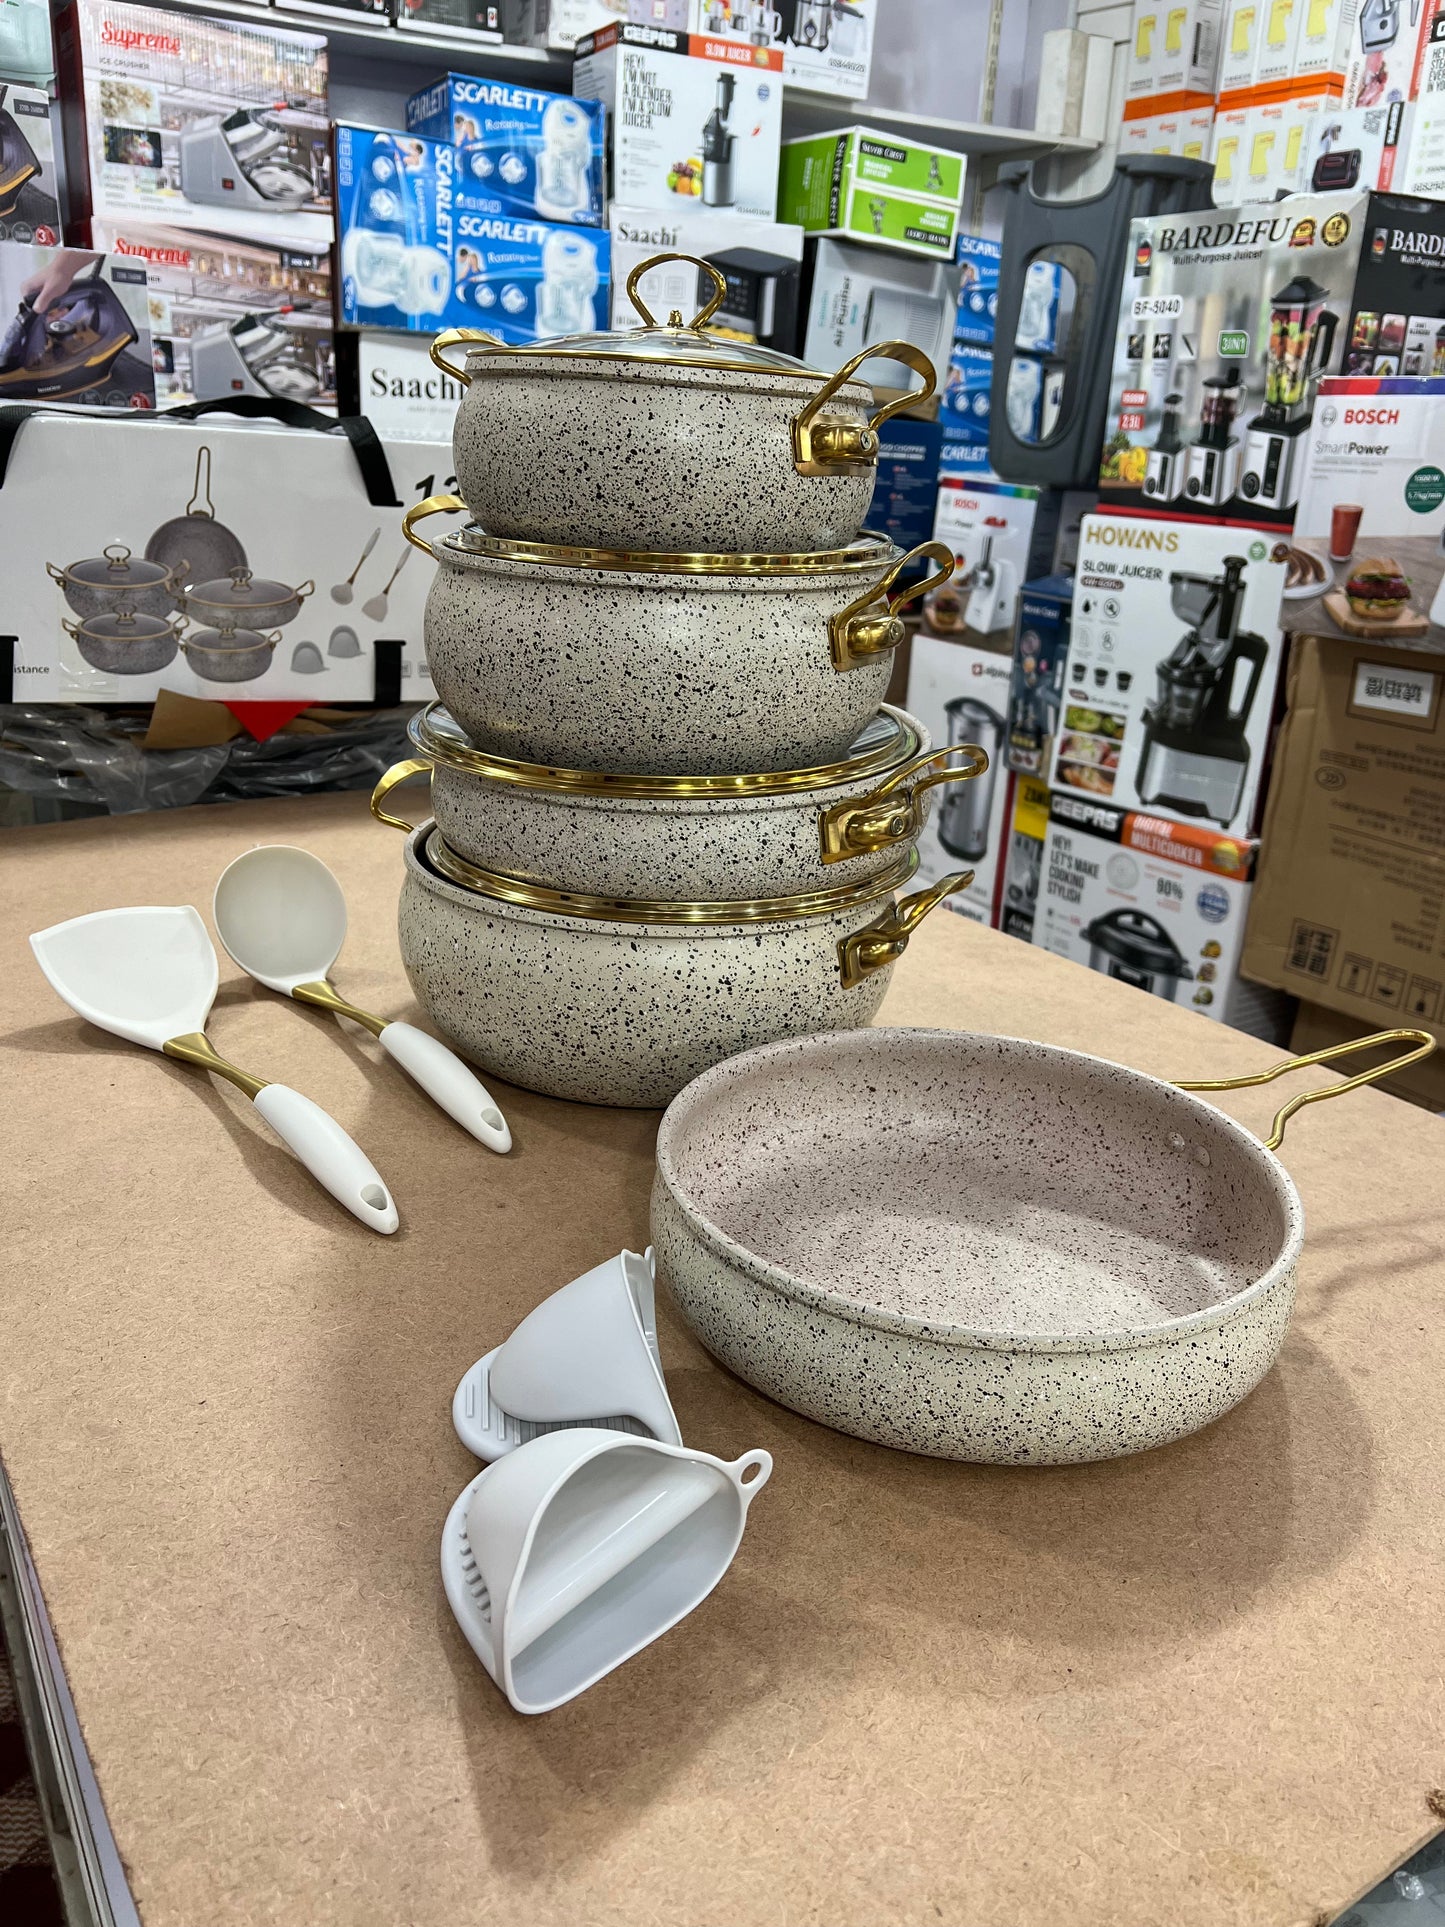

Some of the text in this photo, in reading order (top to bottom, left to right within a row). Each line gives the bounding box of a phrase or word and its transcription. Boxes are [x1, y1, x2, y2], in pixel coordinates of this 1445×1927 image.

[101, 20, 181, 54] Supreme
[705, 43, 752, 62] SLOW JUICER
[453, 81, 548, 113] SCARLETT
[434, 145, 453, 256] SCARLETT
[457, 215, 550, 246] SCARLETT
[617, 222, 677, 247] Saachi
[1159, 217, 1293, 252] BARDEFU
[115, 238, 191, 266] Supreme
[833, 328, 844, 347] Air
[1344, 409, 1400, 425] BOSCH
[1315, 441, 1390, 455] SmartPower
[1086, 524, 1180, 553] HOWANS
[1083, 560, 1163, 580] SLOW JUICER
[1052, 795, 1119, 833] GEEPAS
[1132, 815, 1174, 839] DIGITAL
[1051, 834, 1072, 850] HEY!
[1131, 833, 1203, 866] MULTICOOKER
[1049, 864, 1085, 889] COOKING
[1050, 850, 1100, 880] LET'S MAKE
[1047, 881, 1082, 905] STYLISH
